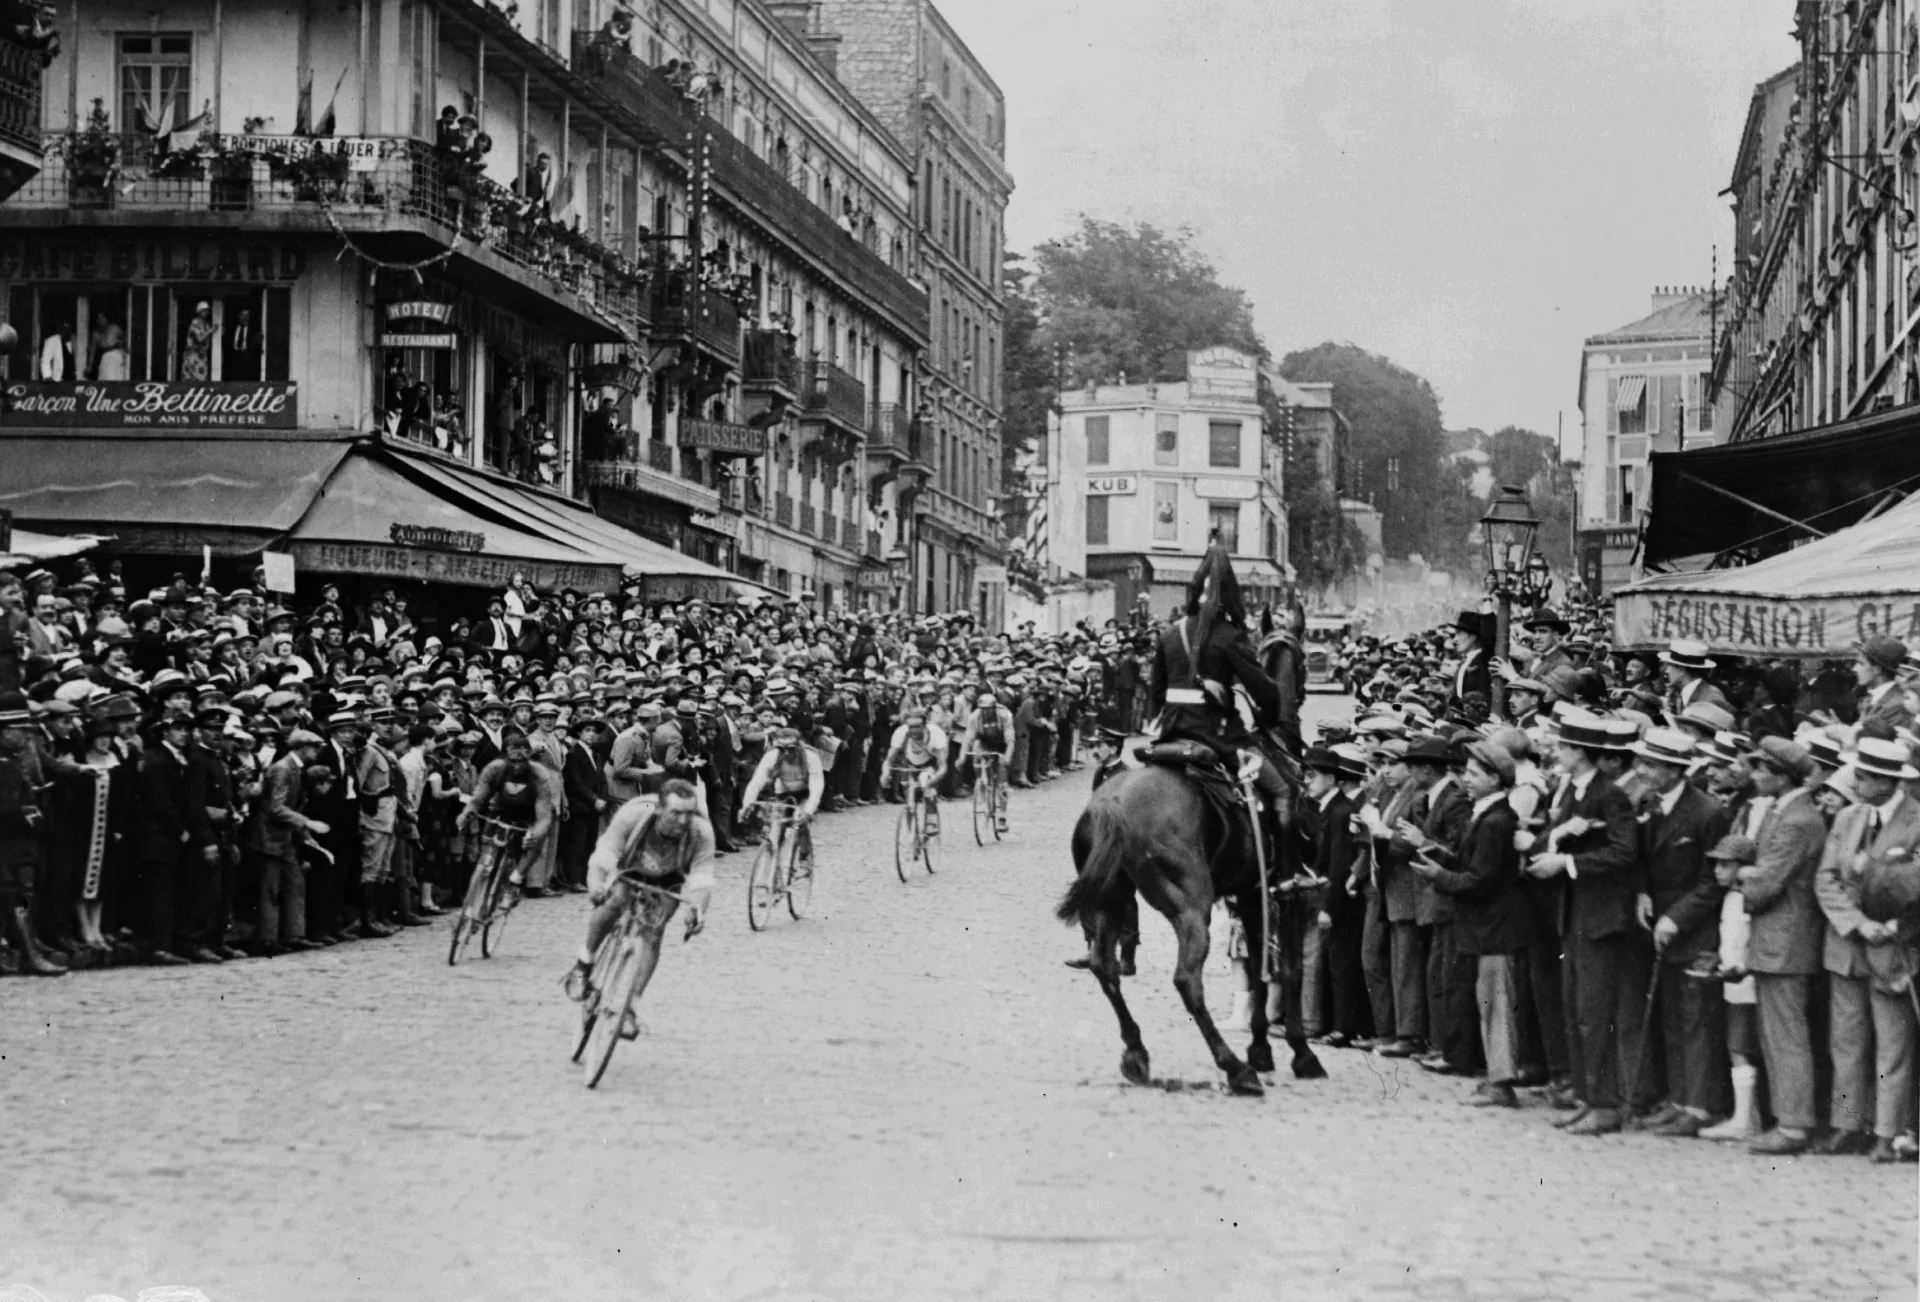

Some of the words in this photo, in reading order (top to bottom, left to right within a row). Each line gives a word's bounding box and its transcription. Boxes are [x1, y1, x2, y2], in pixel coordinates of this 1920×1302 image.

[109, 242, 306, 278] BILLARD
[389, 302, 446, 322] HOTEL
[382, 334, 451, 346] RESTAURANT
[123, 415, 152, 424] MON
[680, 420, 763, 453] PATISSERIE
[1088, 479, 1129, 491] KUB
[1650, 596, 1827, 649] DÉGUSTATION
